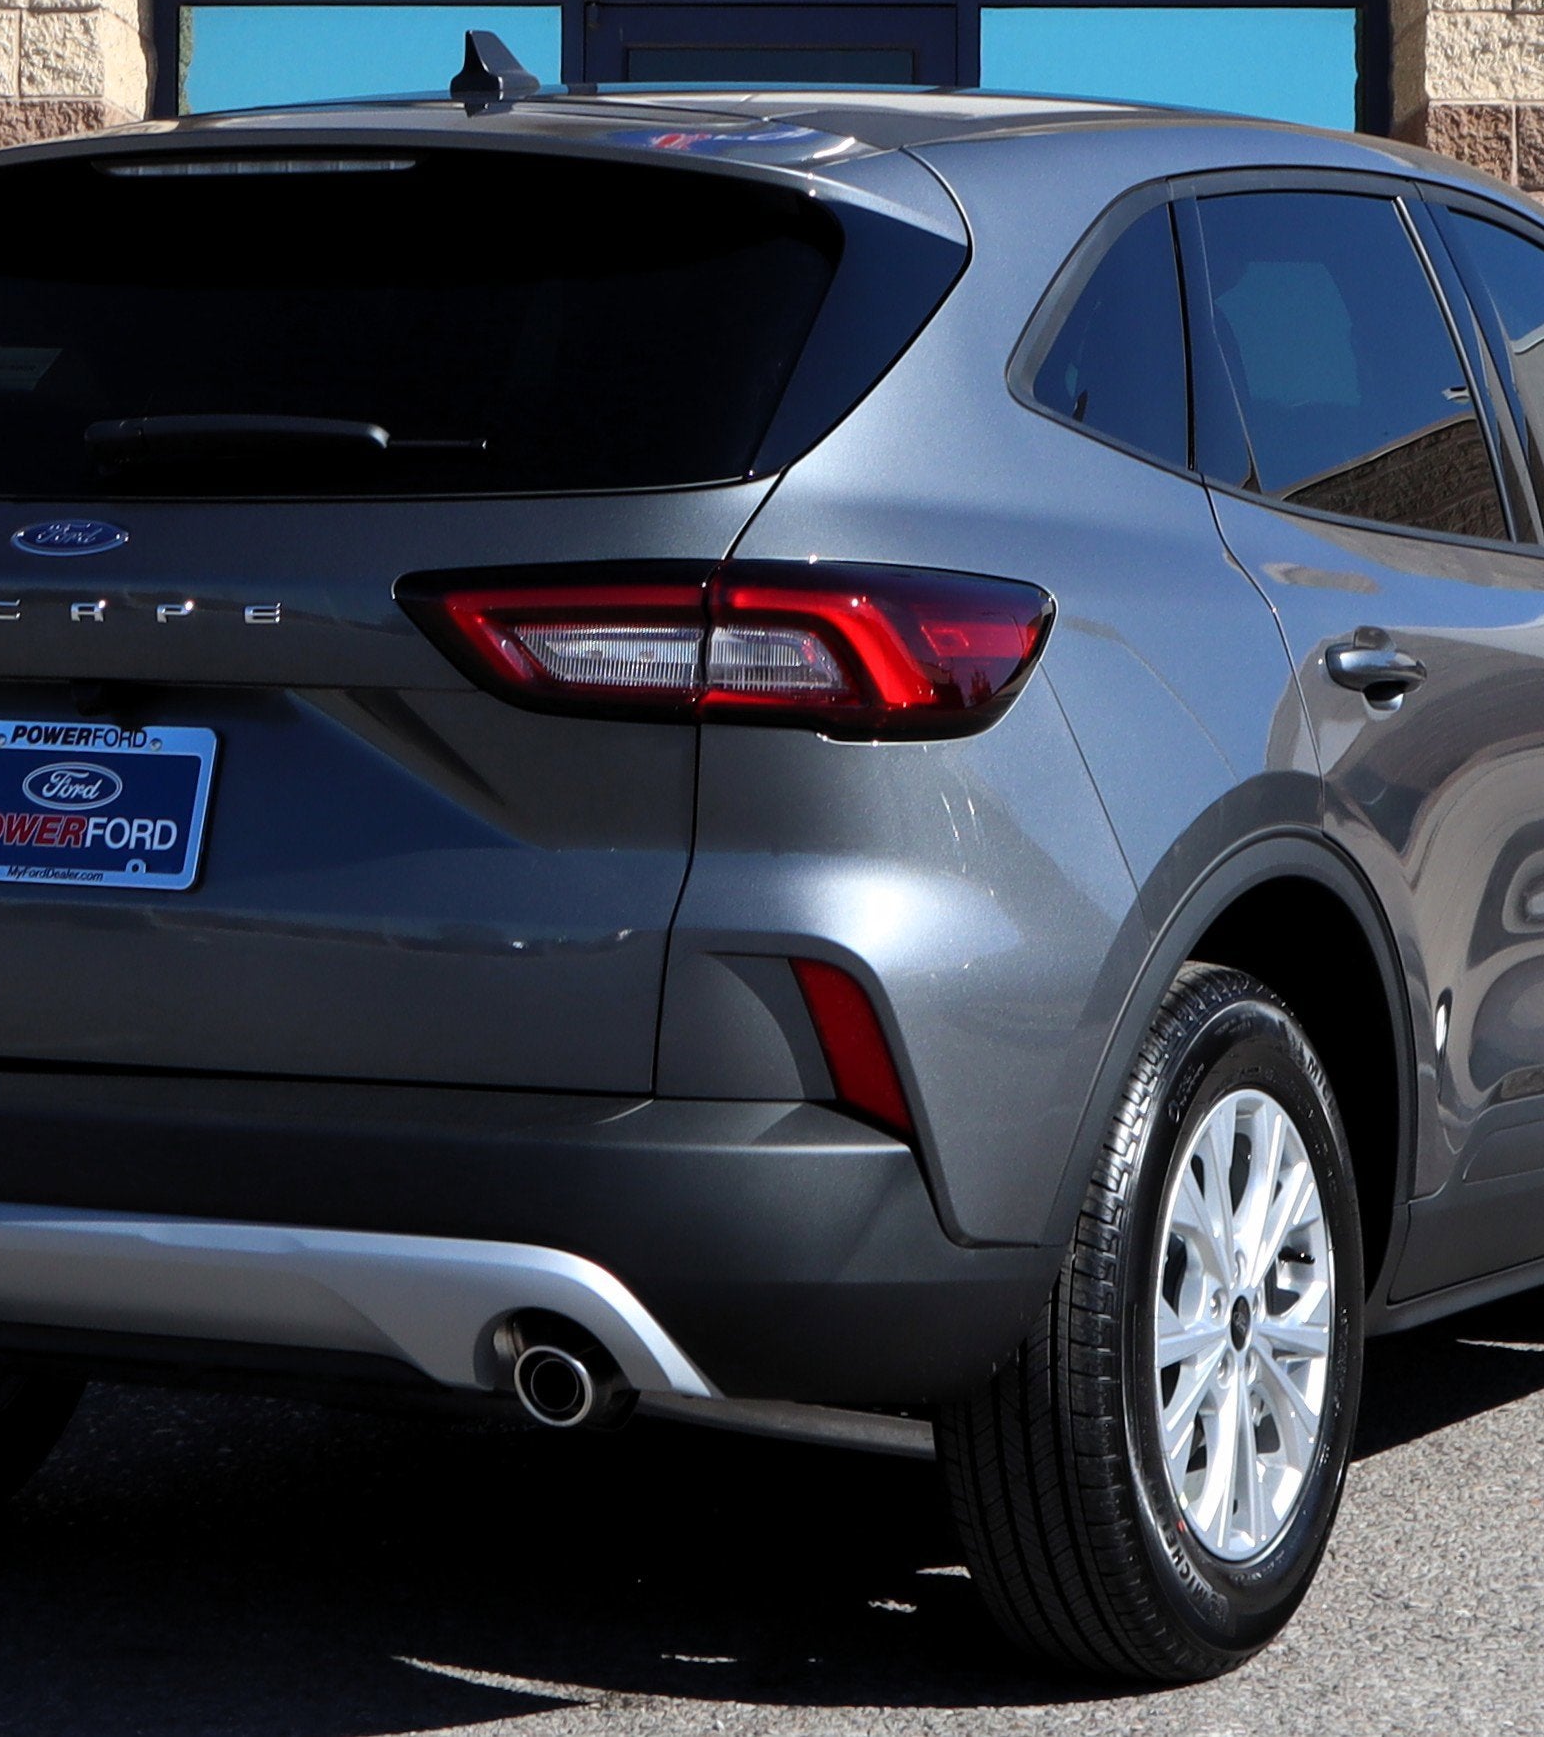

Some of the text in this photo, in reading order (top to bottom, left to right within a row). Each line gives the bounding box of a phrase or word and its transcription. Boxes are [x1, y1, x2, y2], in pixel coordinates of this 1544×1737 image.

[35, 522, 105, 545] Ford
[10, 724, 148, 749] POWERFORD
[41, 769, 104, 800] Ford
[7, 865, 104, 883] MyFordDealer.com
